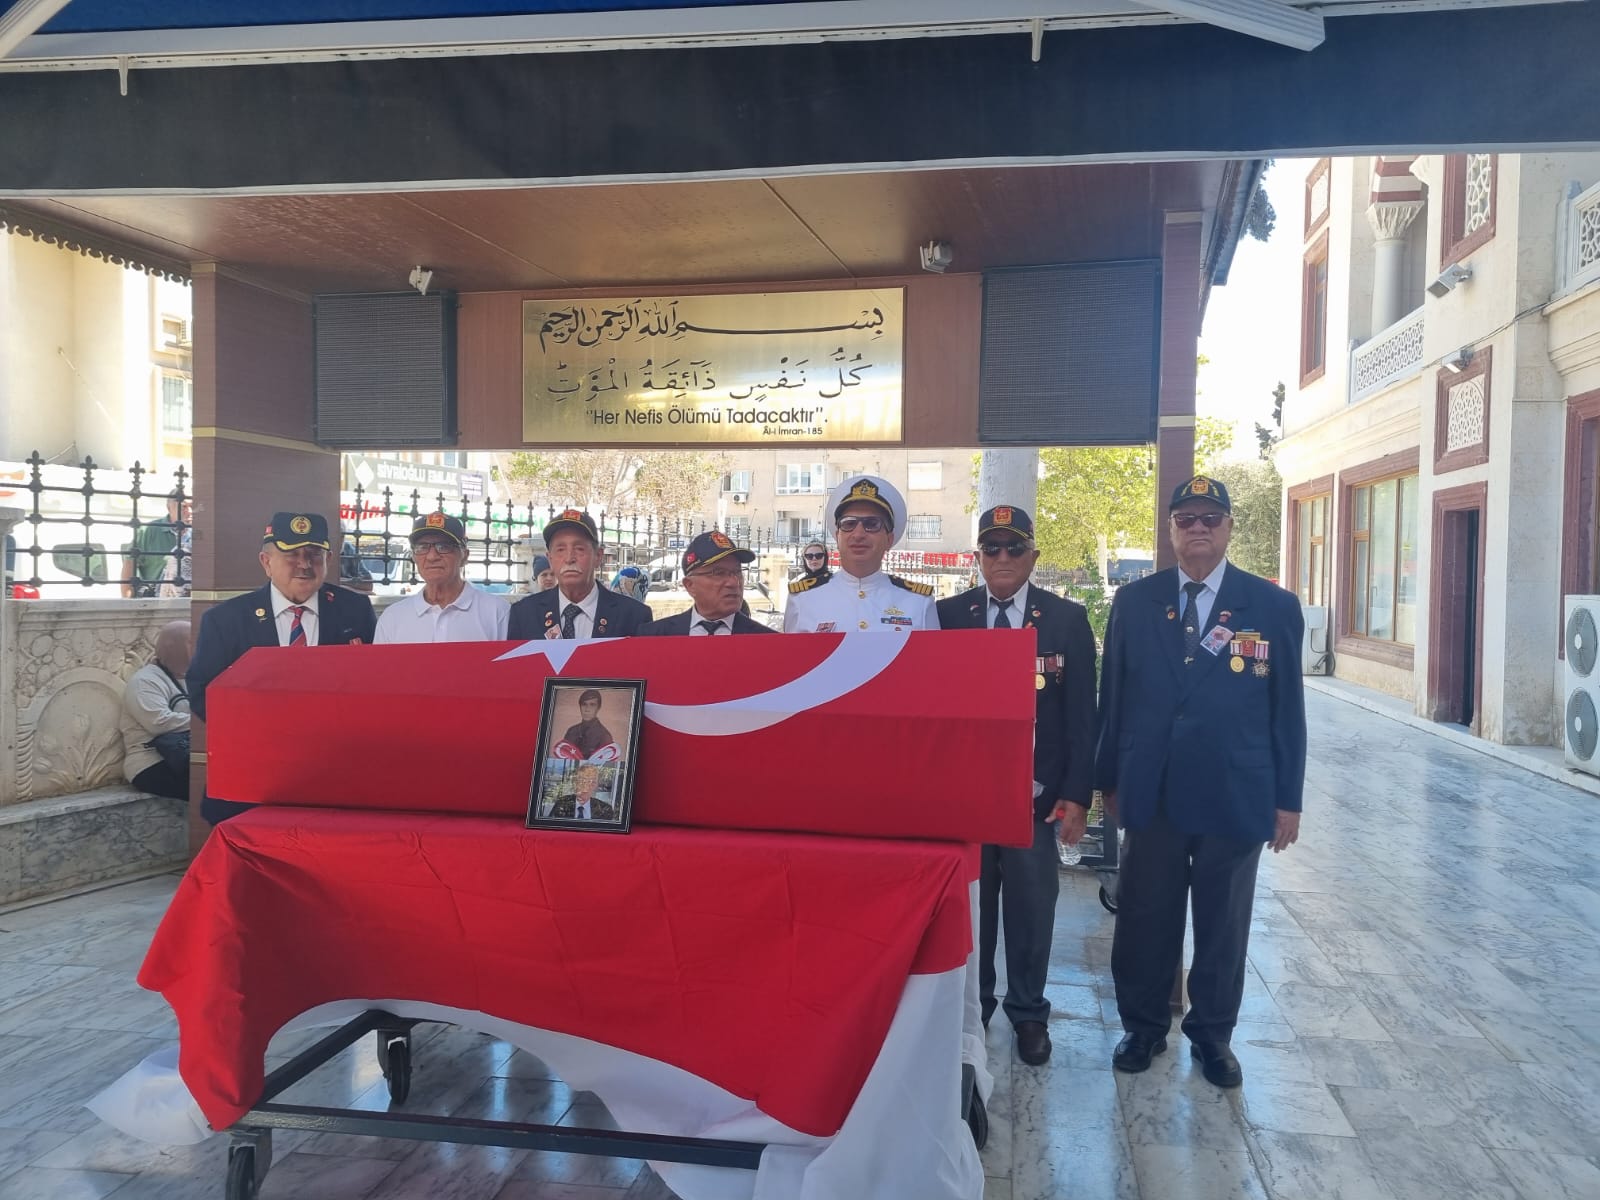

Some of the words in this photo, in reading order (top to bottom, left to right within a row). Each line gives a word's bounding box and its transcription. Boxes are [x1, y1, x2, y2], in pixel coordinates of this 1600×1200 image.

[625, 408, 663, 425] Nefis
[667, 404, 721, 424] Ölümü
[377, 461, 426, 482] SİVRİOĞLU
